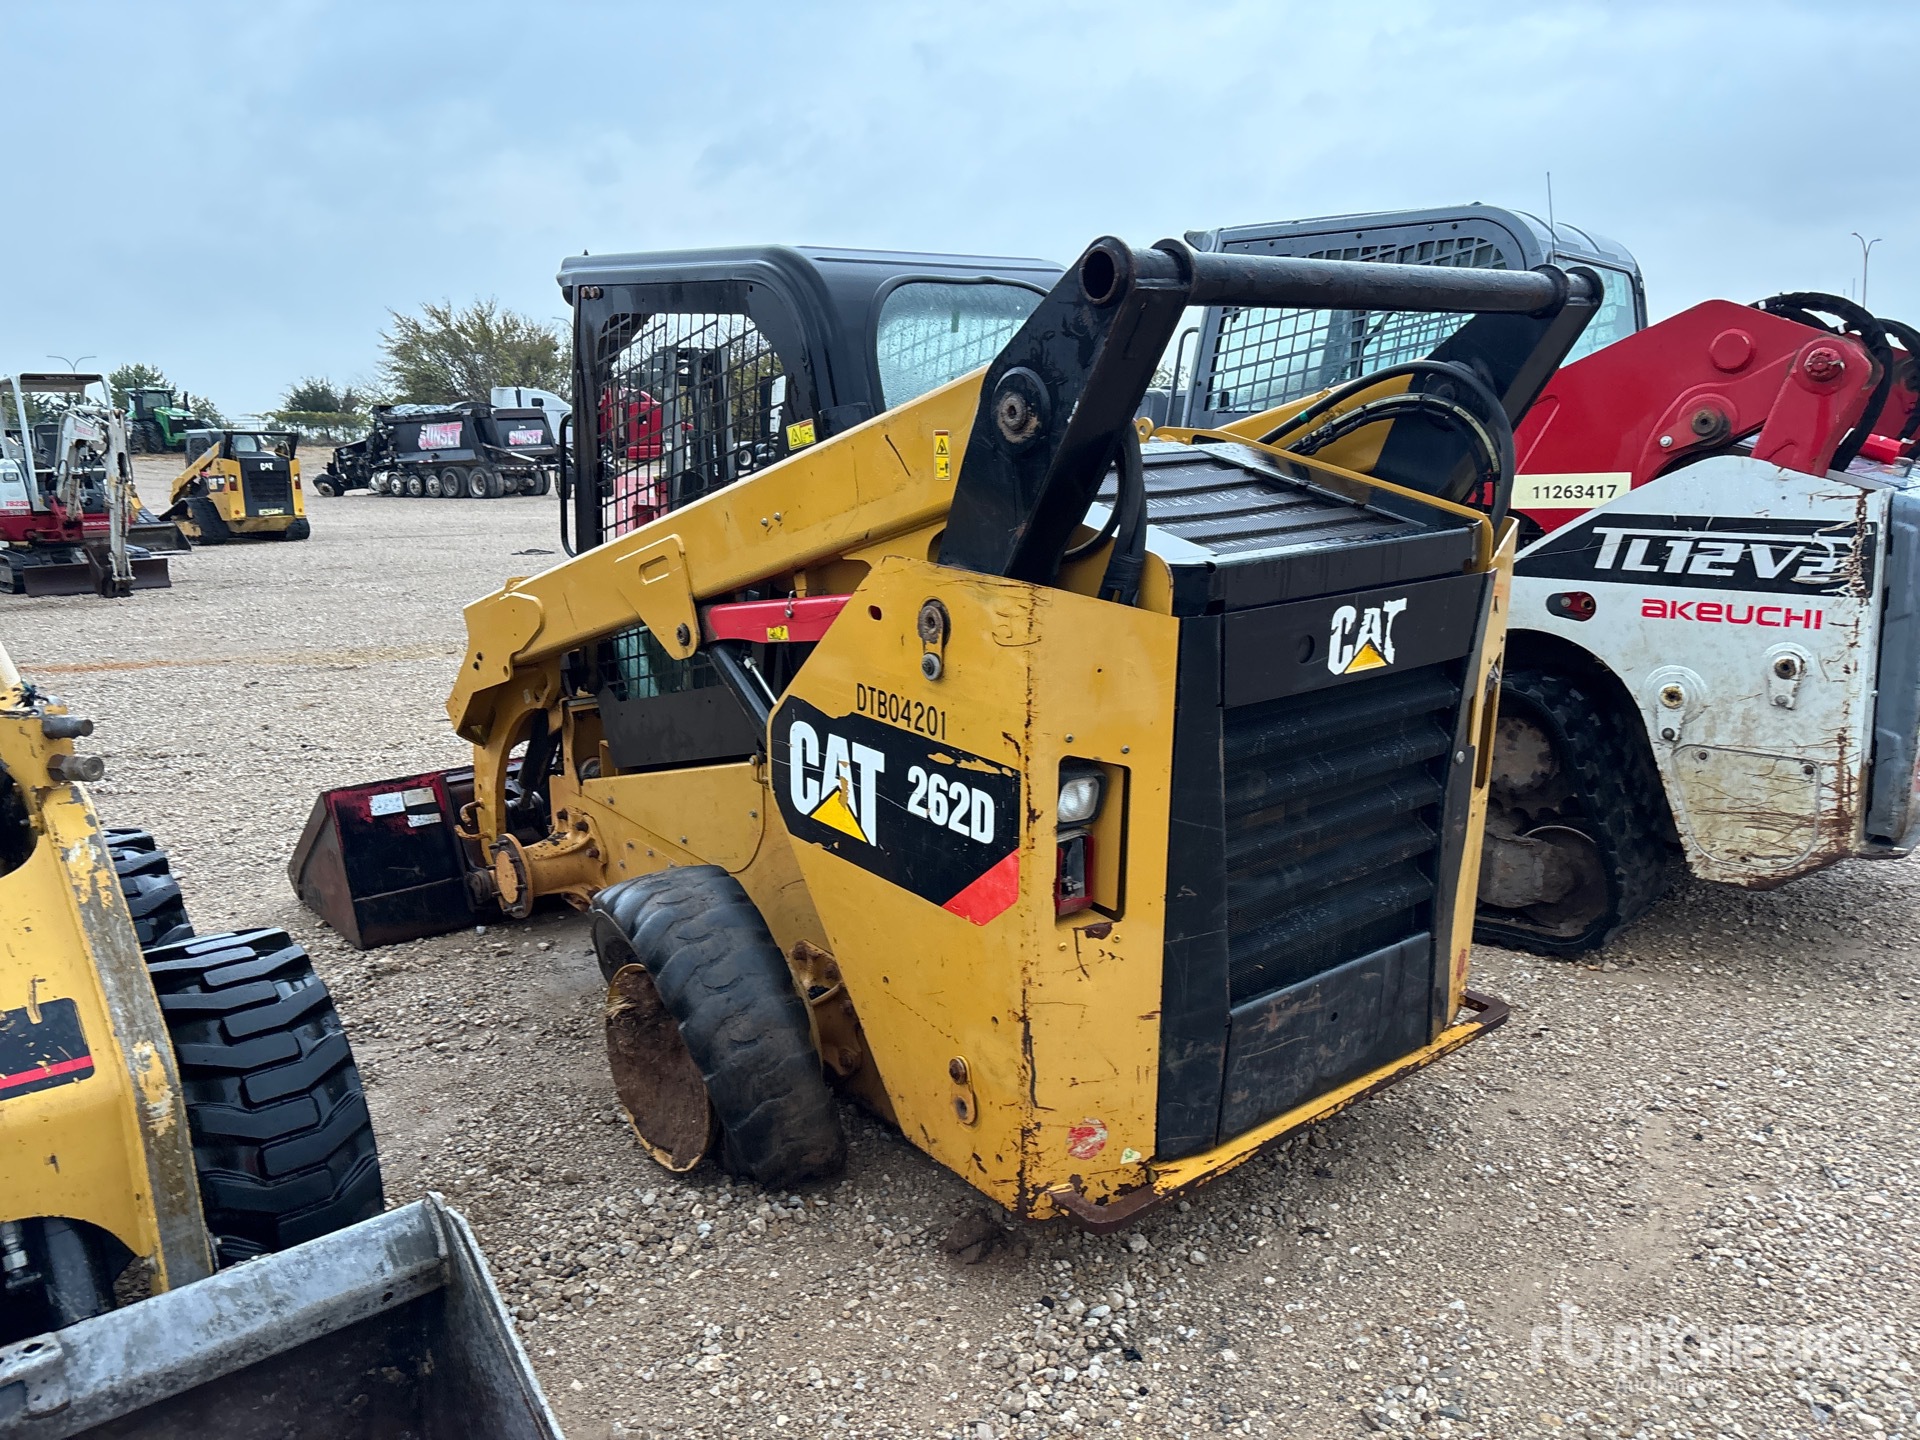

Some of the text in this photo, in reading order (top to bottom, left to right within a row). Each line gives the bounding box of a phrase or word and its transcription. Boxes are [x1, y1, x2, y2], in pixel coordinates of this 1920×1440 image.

[418, 421, 463, 450] SUNSET
[508, 429, 543, 446] SUNSET
[259, 462, 274, 471] CAT
[1532, 484, 1618, 500] 11263417
[1327, 597, 1408, 676] CAT
[856, 682, 947, 741] DTB04201
[789, 720, 996, 848] CAT 262D
